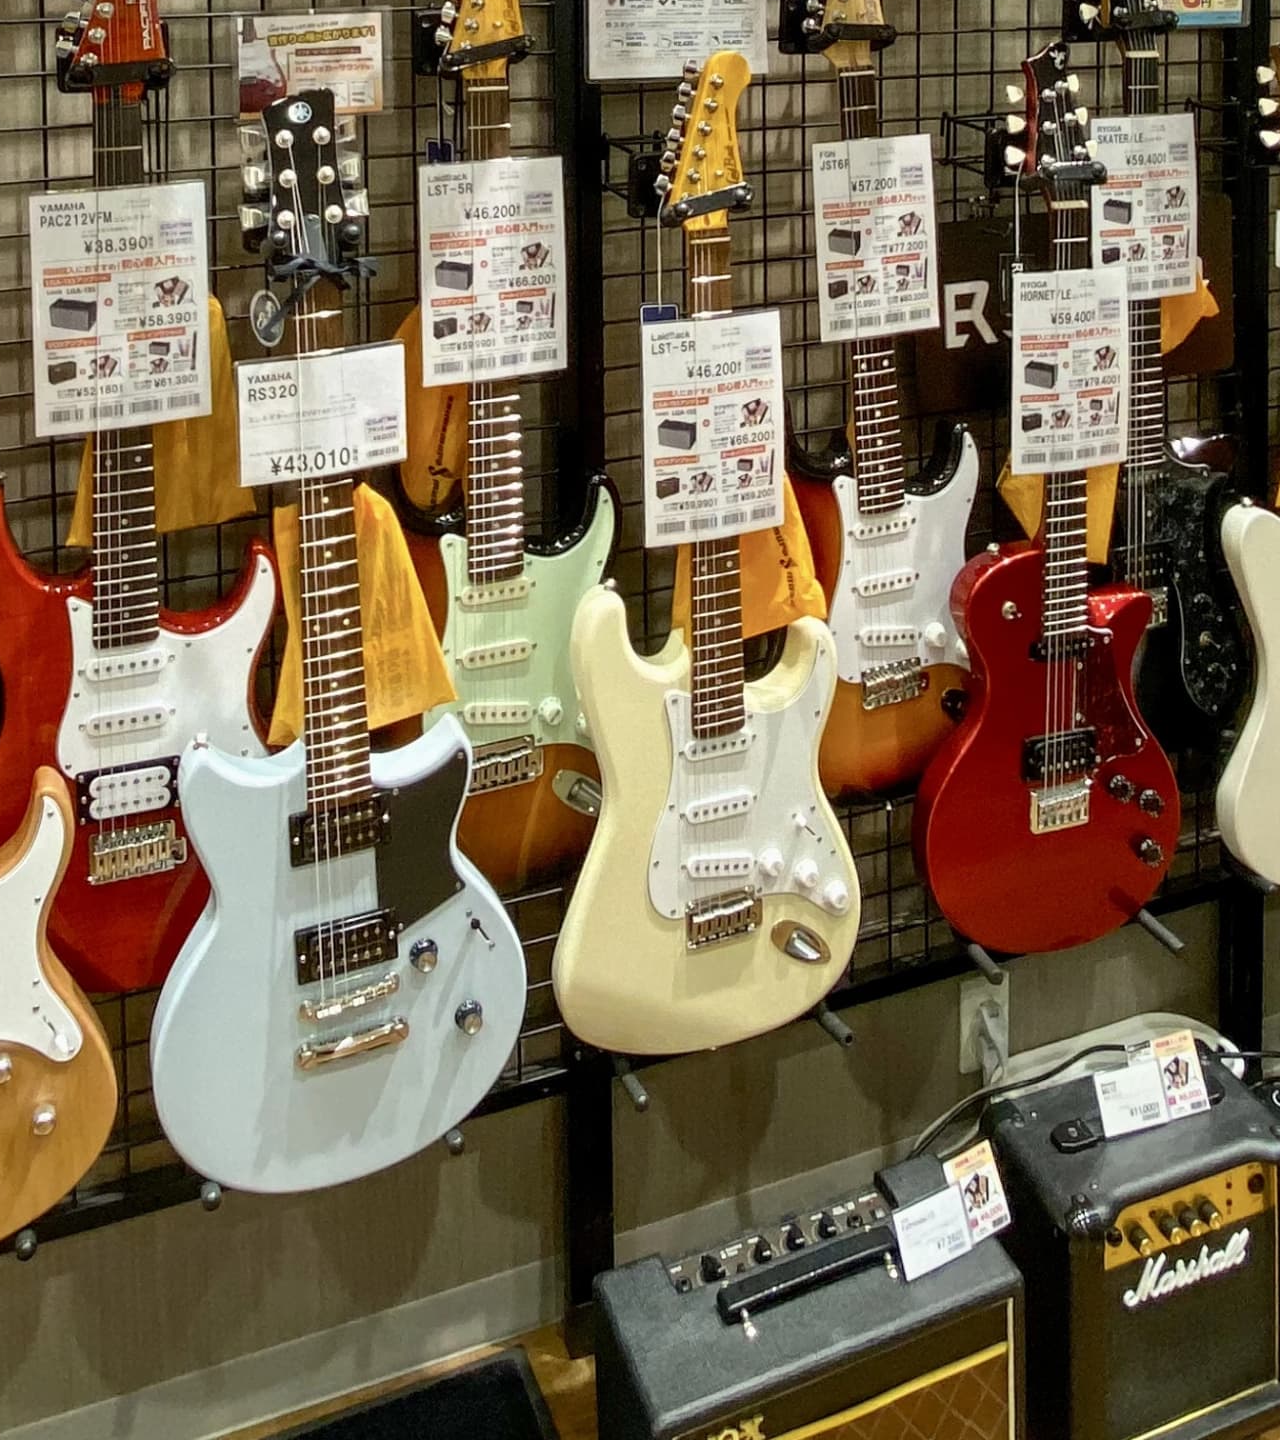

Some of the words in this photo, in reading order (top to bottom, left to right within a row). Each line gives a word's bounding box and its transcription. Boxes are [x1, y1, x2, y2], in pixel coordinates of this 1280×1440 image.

[40, 202, 86, 213] YAMAHA
[40, 212, 113, 228] PAC212VFM
[1020, 288, 1071, 302] HORNET/LE
[651, 340, 696, 356] LST-5R
[247, 371, 293, 385] YAMAHA
[247, 383, 299, 403] RS320
[270, 447, 351, 477] ¥43,010
[1123, 1228, 1250, 1307] Marshall
